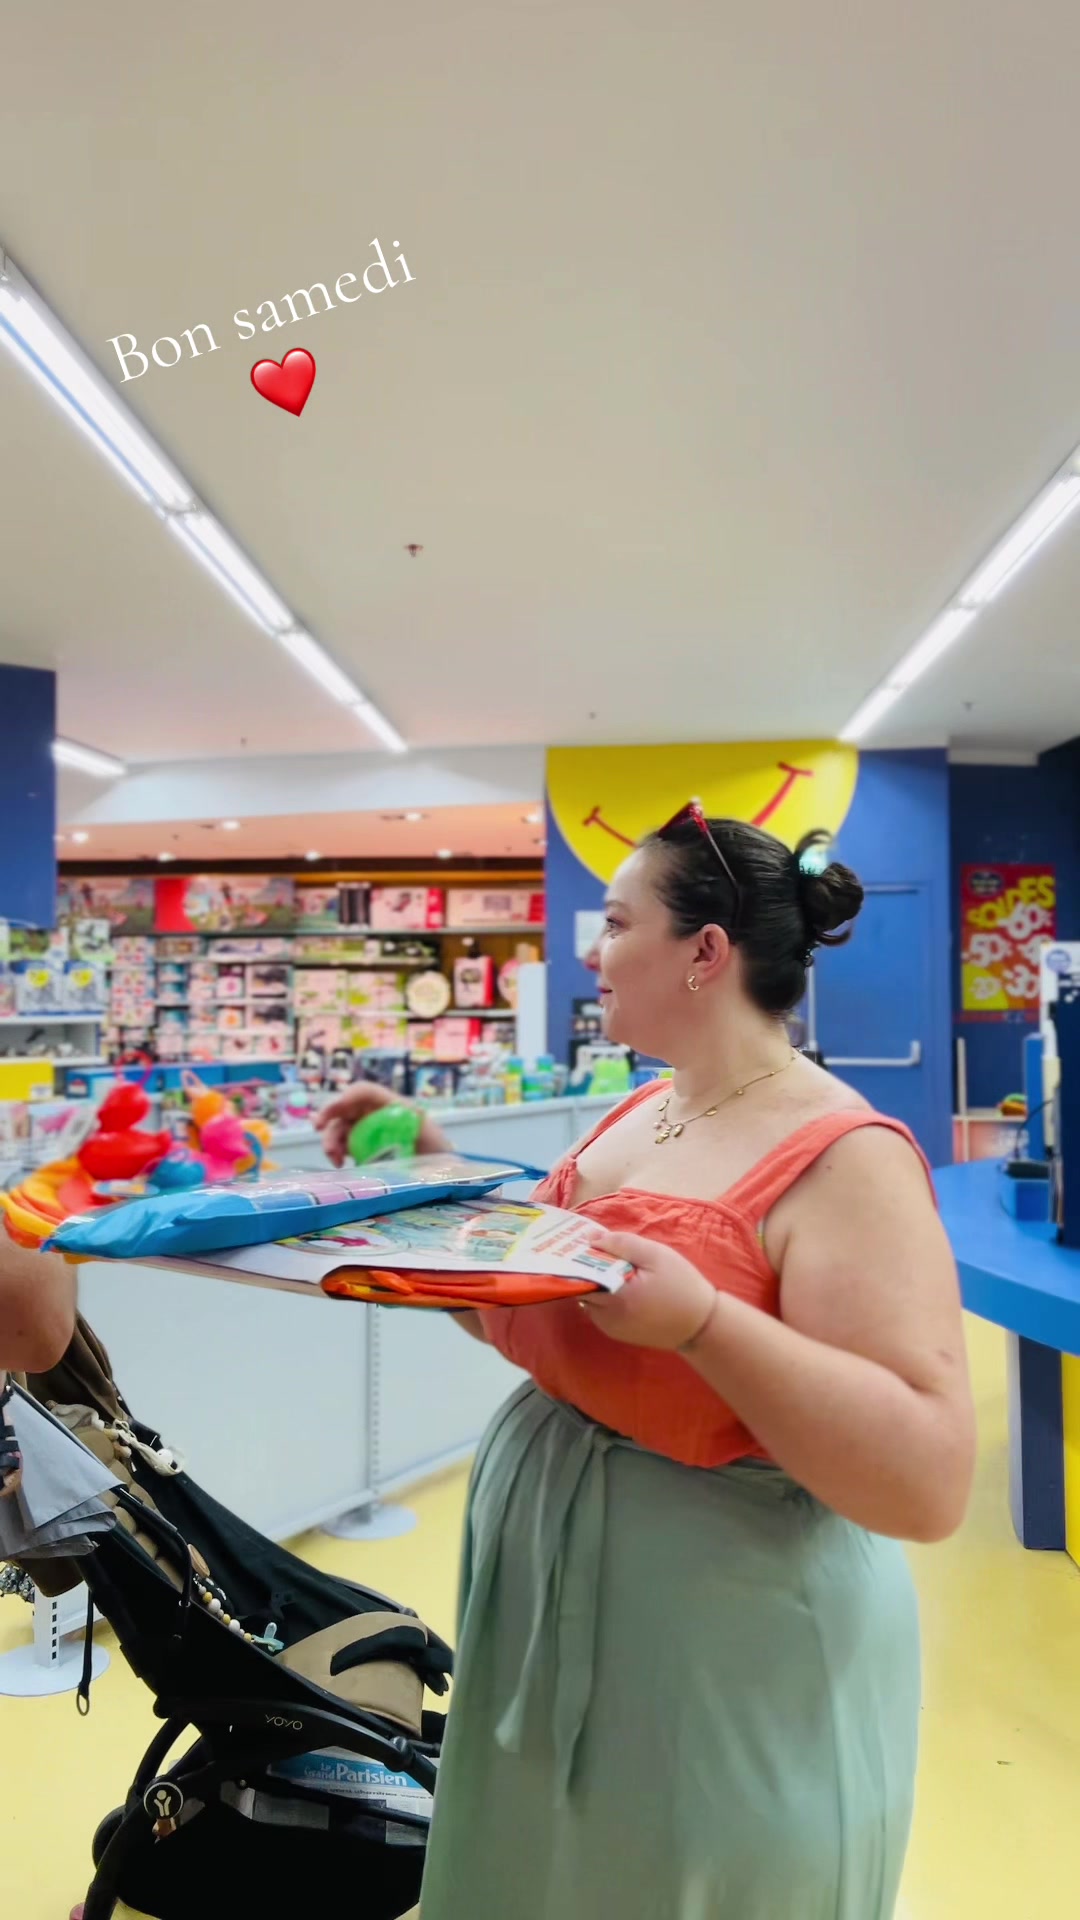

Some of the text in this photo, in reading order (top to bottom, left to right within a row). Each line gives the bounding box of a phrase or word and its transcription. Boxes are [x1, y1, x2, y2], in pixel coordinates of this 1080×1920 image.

[967, 876, 1056, 929] SOLDES
[265, 1714, 303, 1730] YOYO
[304, 1762, 408, 1787] Grand Parisien
[321, 1762, 332, 1772] Le
